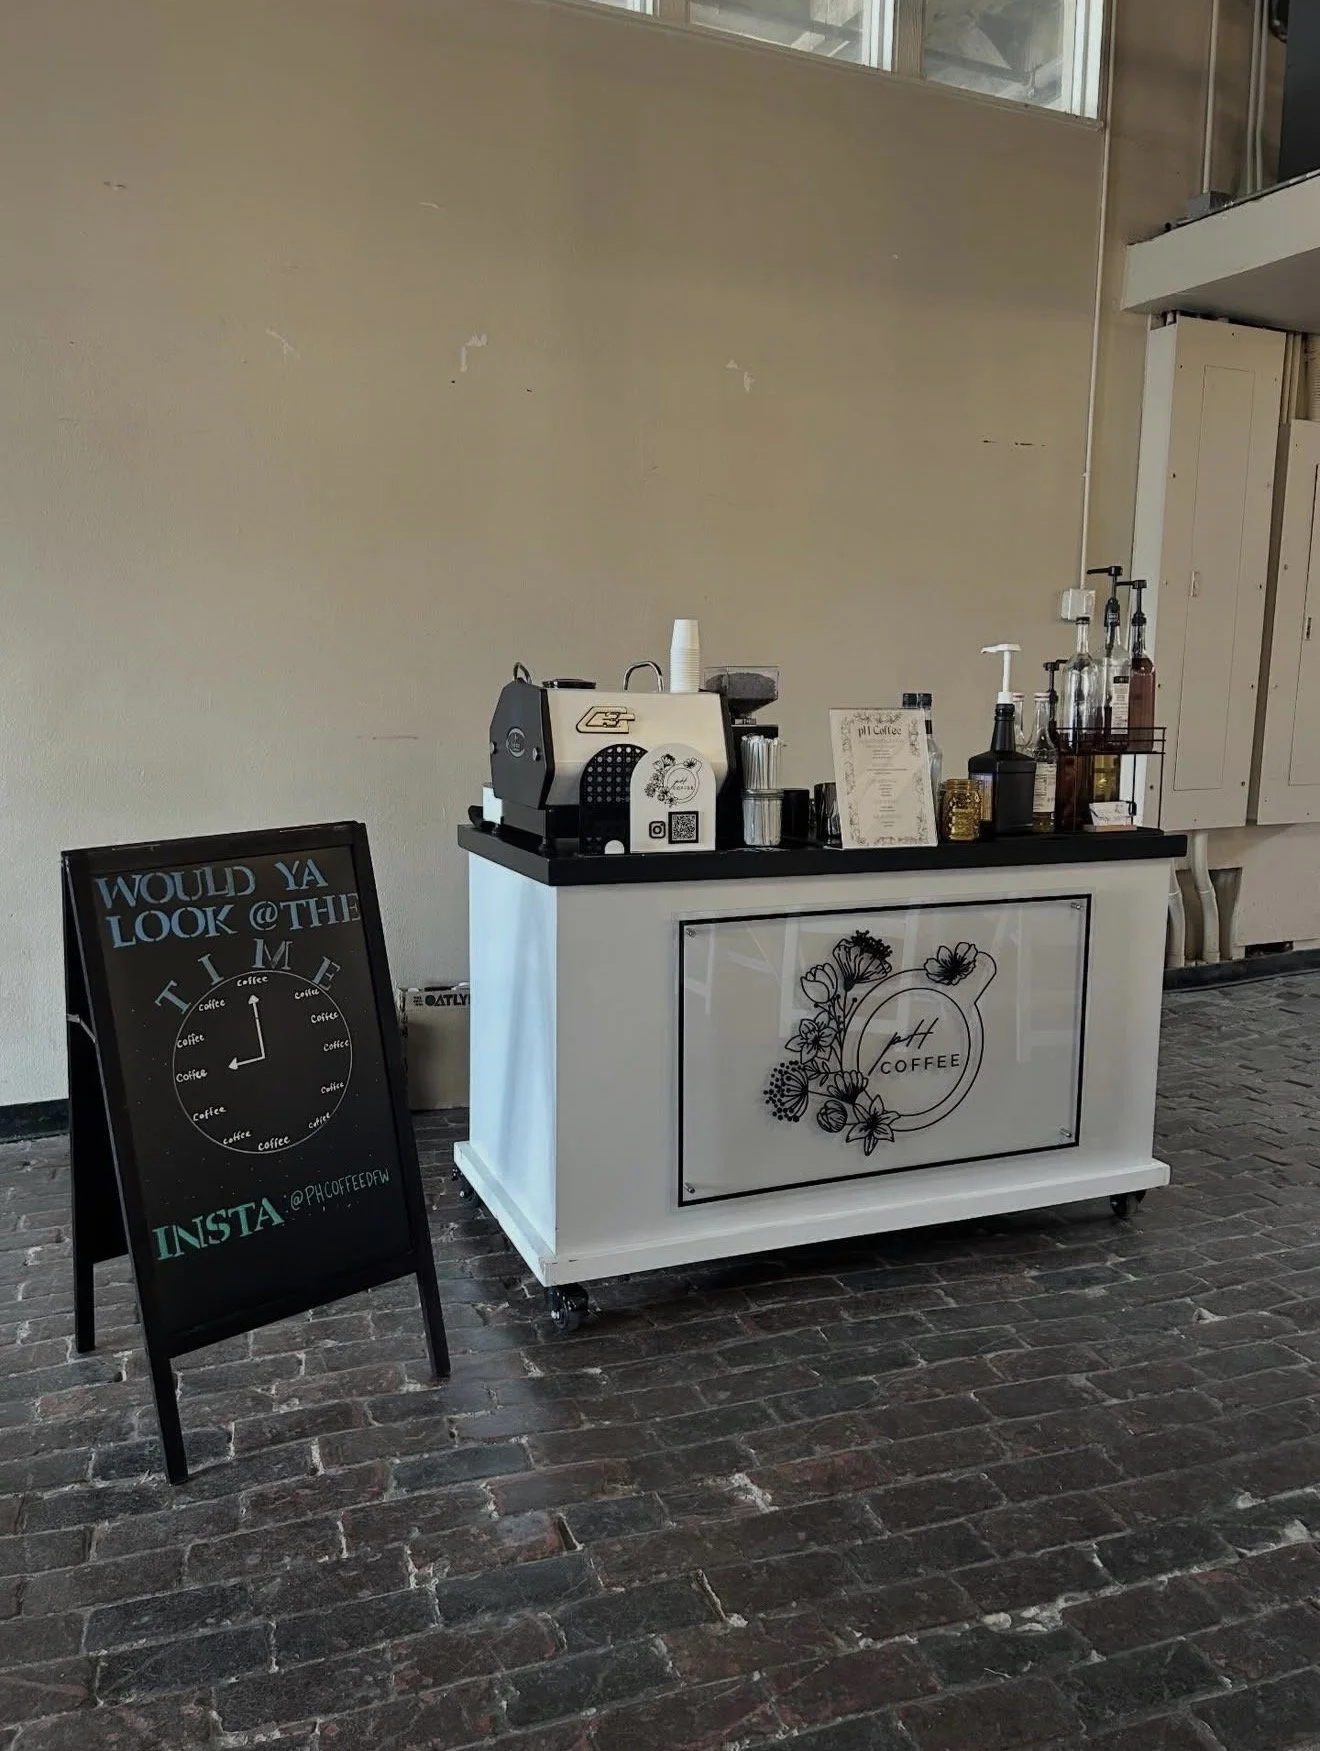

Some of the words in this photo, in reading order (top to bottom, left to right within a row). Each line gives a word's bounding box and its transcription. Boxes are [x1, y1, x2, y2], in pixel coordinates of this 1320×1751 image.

[94, 865, 256, 909] WOULD
[275, 858, 329, 891] YA
[106, 903, 238, 948] LOOK
[880, 1053, 960, 1074] COFFEE
[152, 1197, 285, 1261] INSTA
[290, 1168, 390, 1211] @PHCOFFEEDFW
